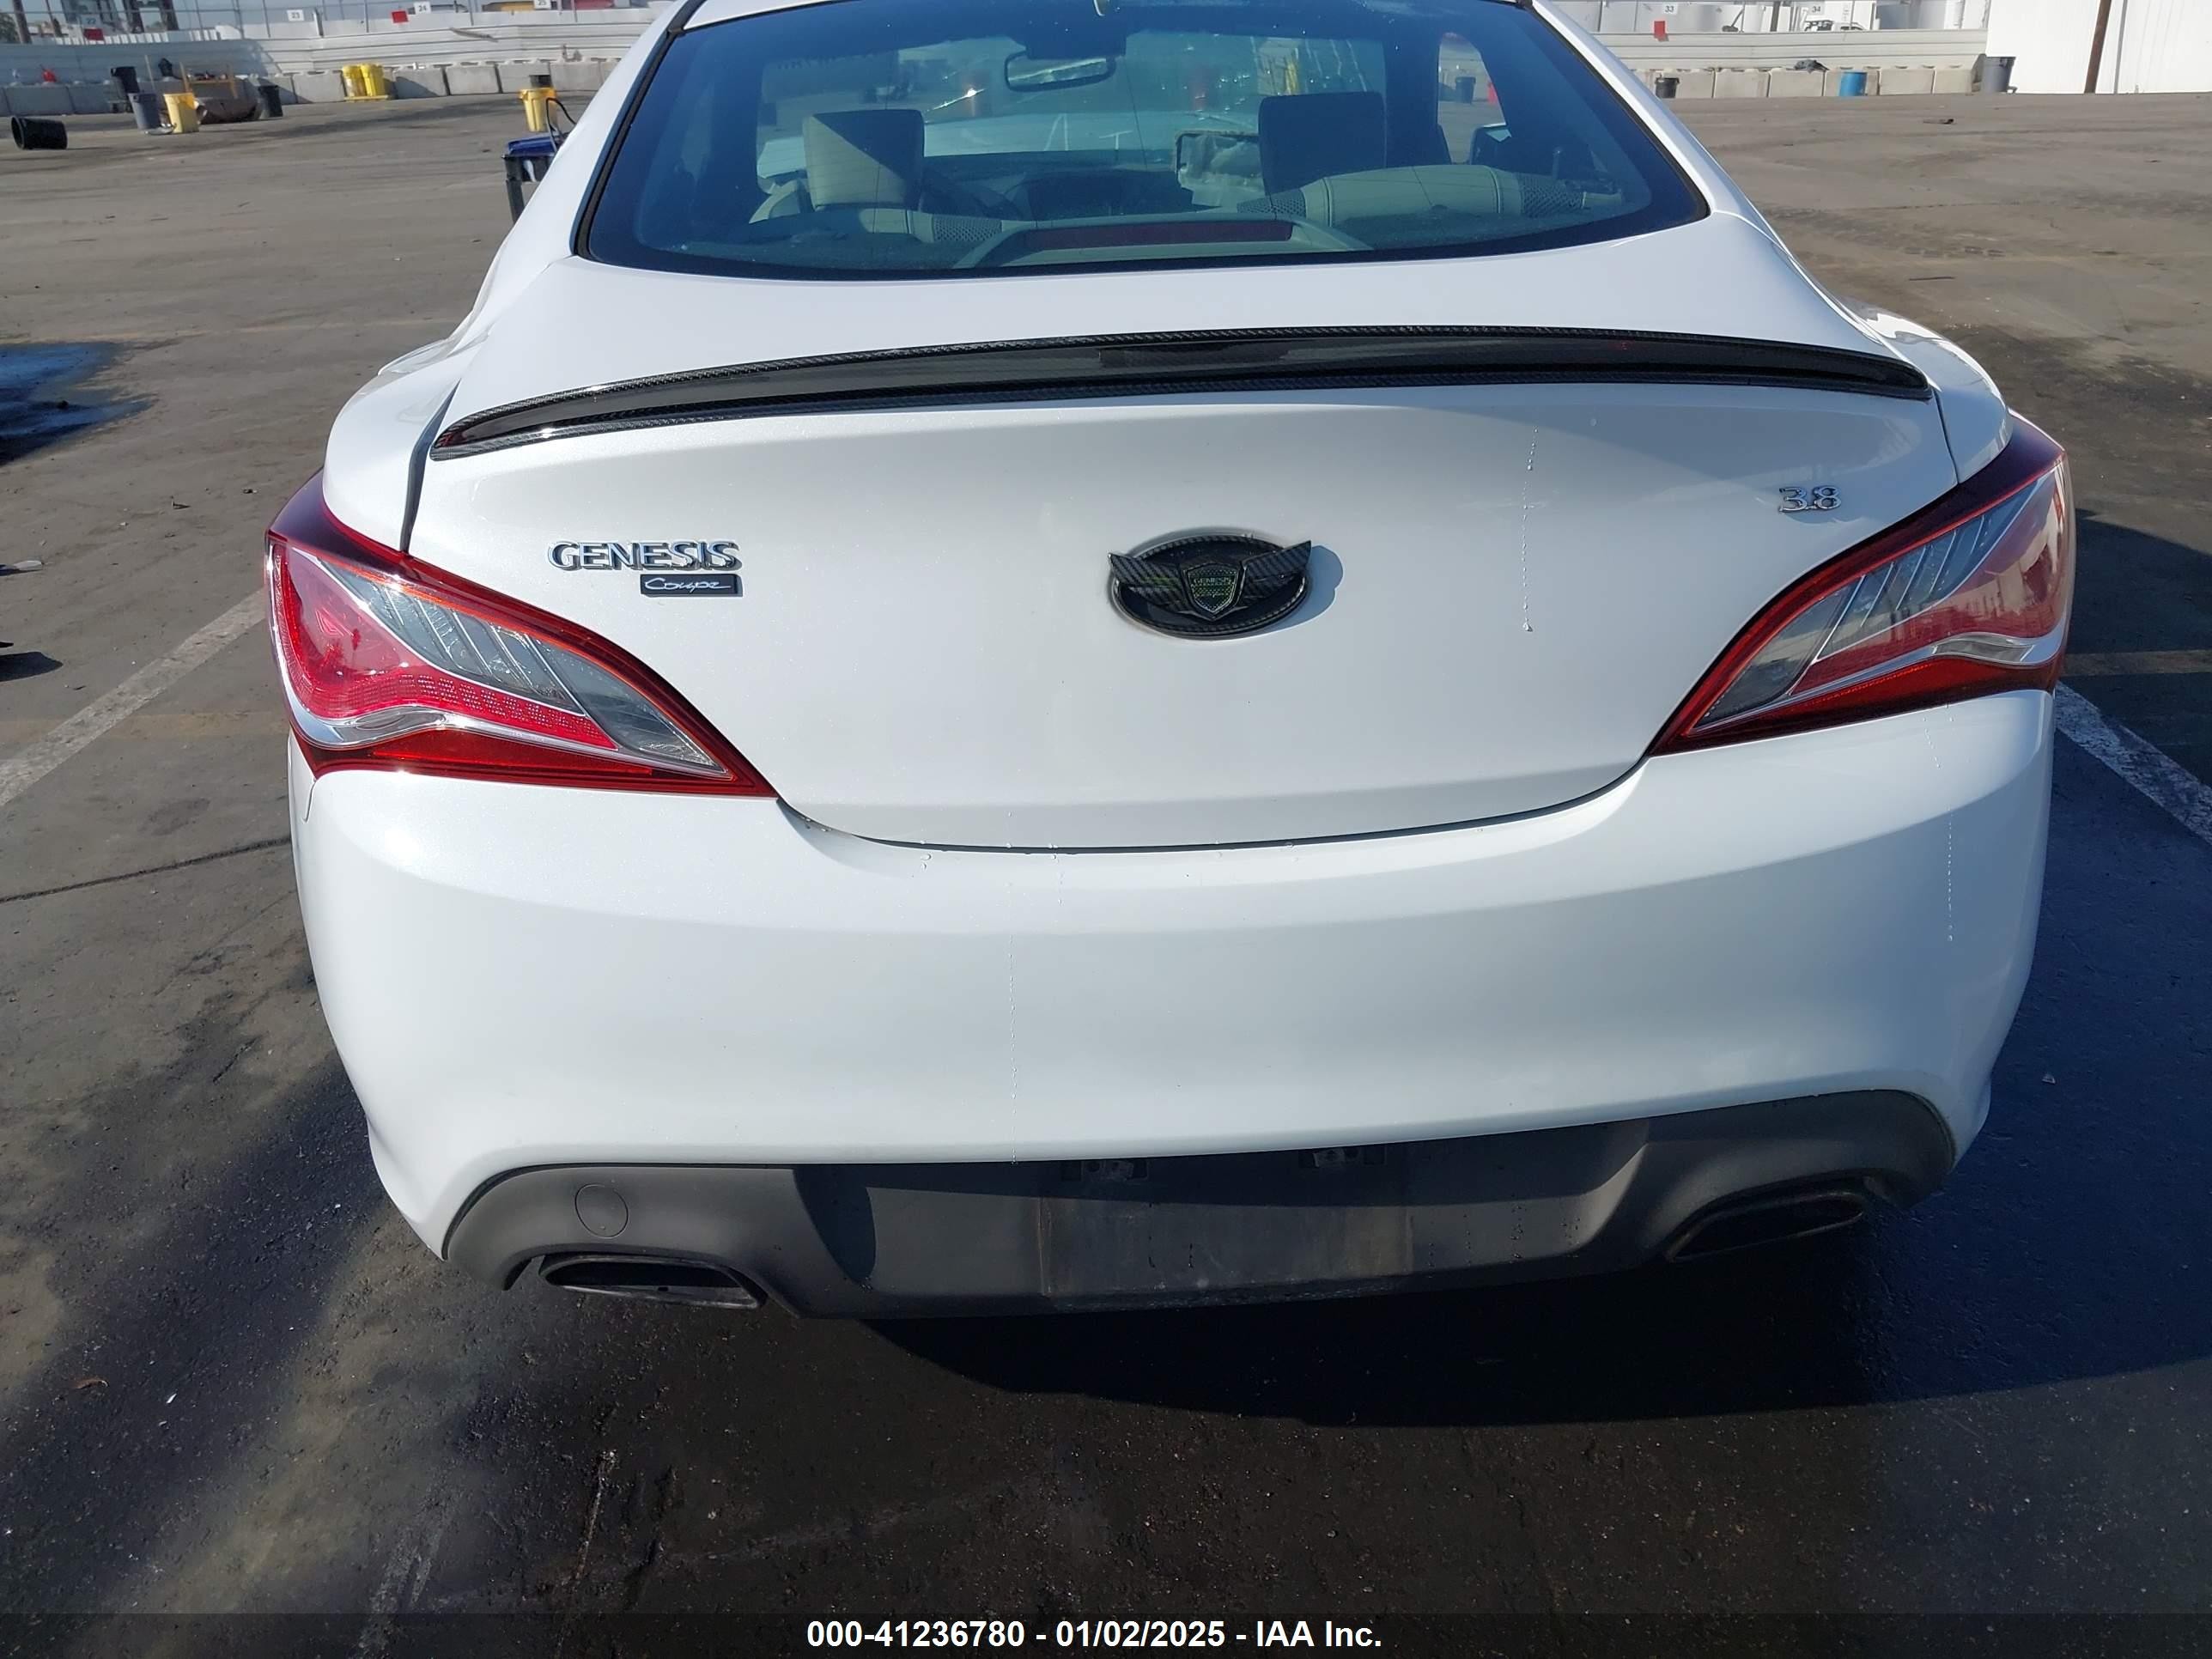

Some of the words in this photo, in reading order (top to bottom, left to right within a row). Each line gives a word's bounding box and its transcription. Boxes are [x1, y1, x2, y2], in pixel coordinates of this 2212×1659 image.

[1778, 486, 1841, 512] 3.8
[548, 540, 742, 572] GENESIS
[644, 577, 732, 593] Coupe
